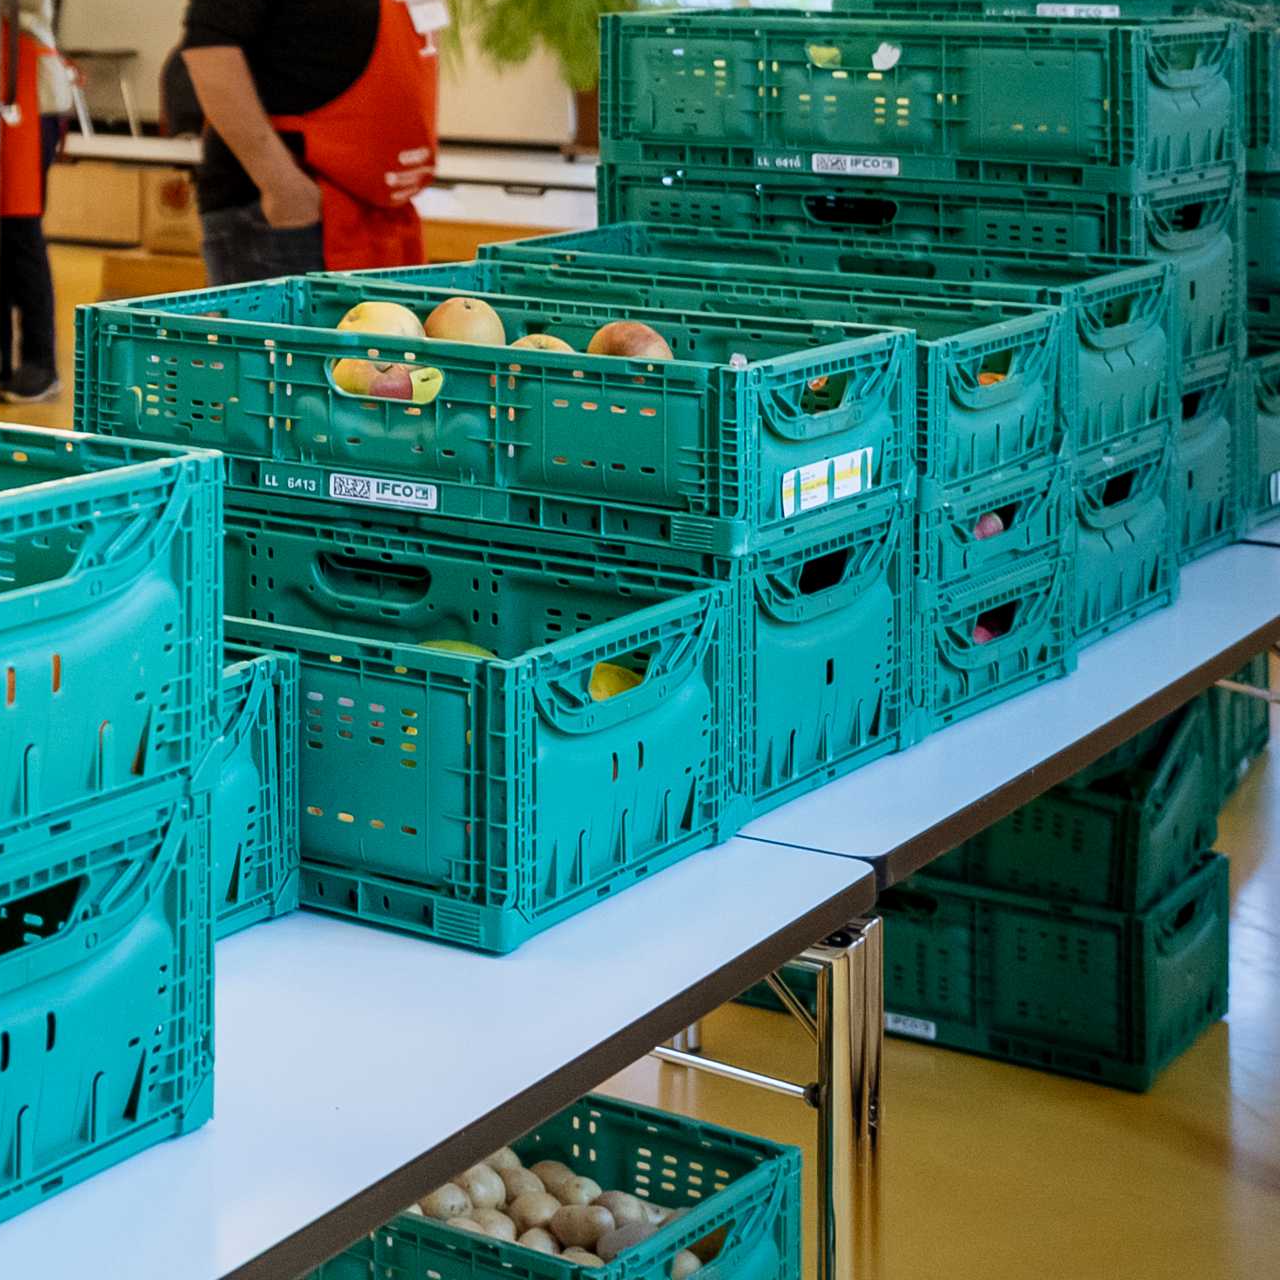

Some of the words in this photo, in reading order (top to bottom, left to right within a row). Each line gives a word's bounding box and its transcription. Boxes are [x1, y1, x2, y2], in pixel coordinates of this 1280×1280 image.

[850, 158, 880, 169] IFCO
[264, 474, 278, 488] LL
[288, 477, 316, 492] 6413
[376, 481, 414, 498] IFCO
